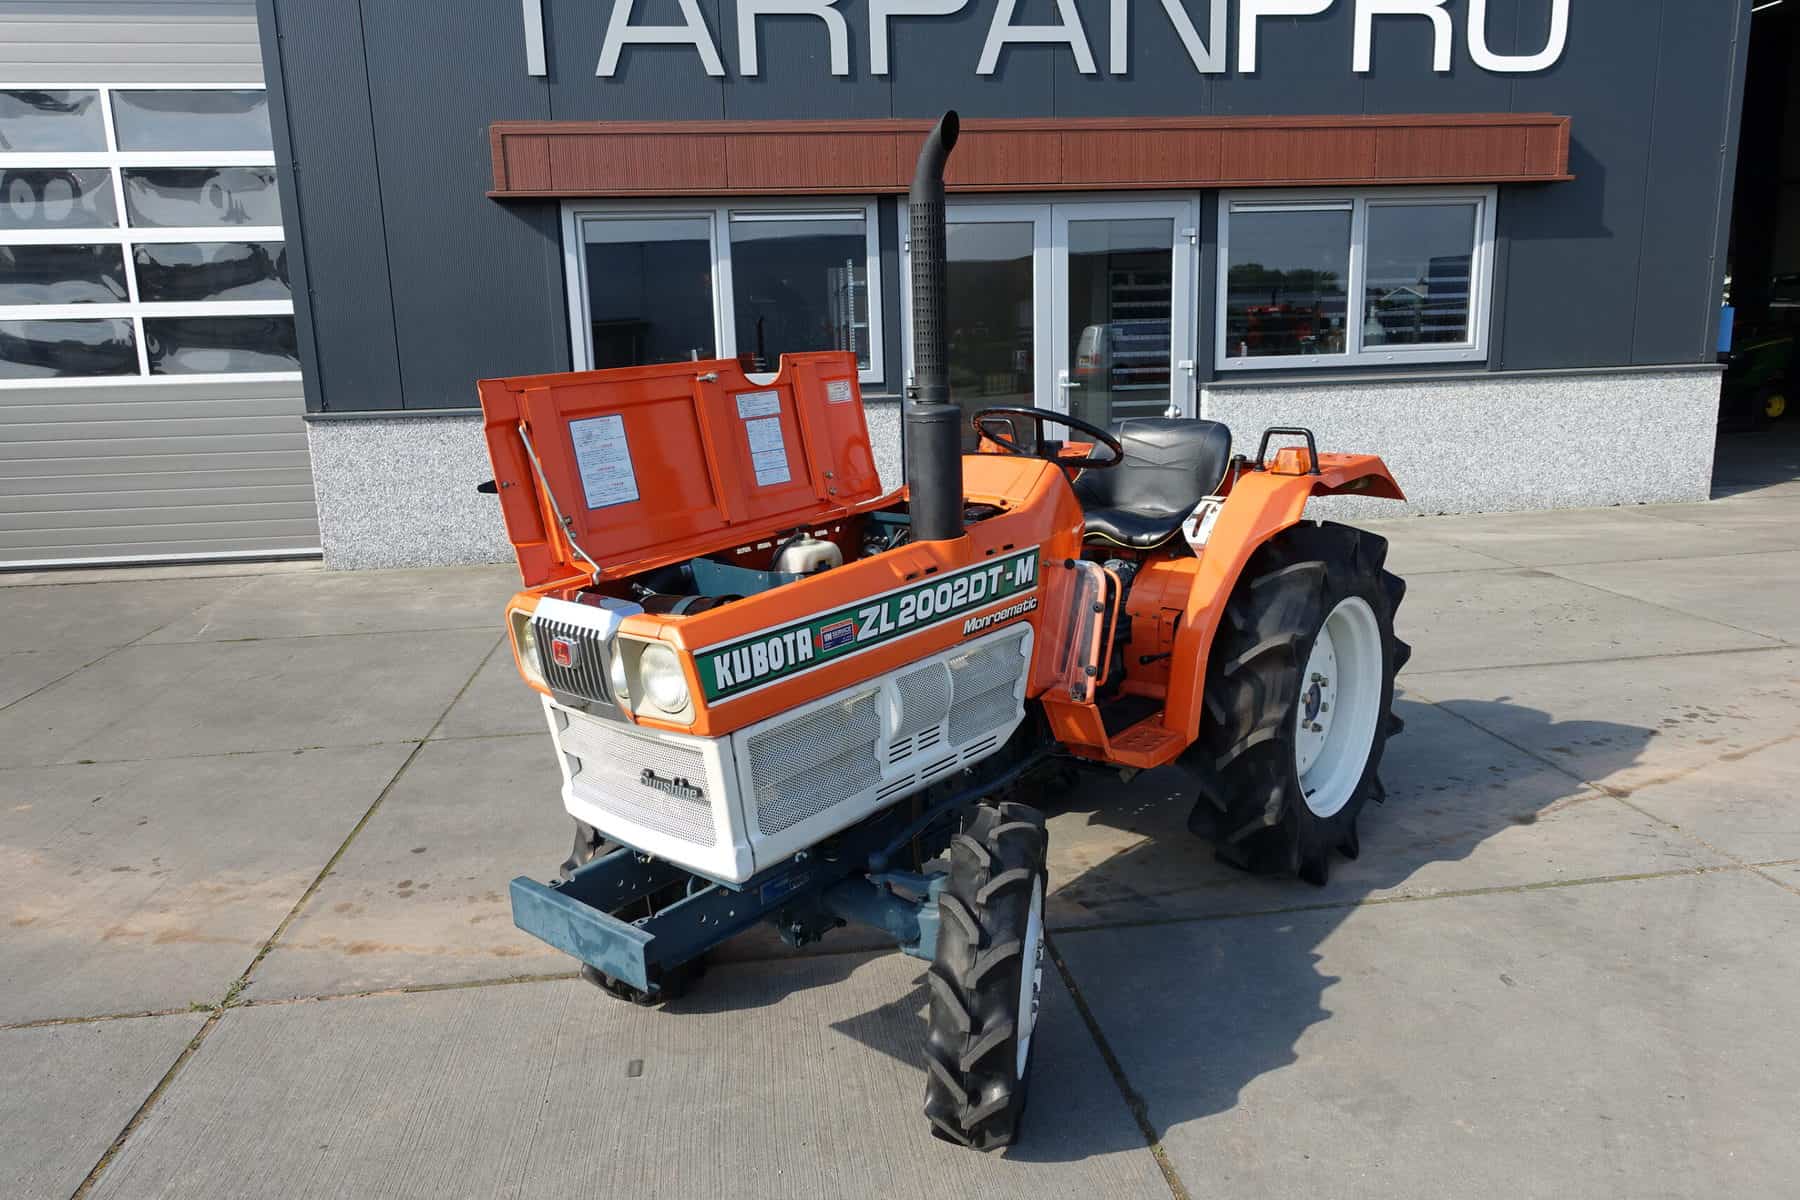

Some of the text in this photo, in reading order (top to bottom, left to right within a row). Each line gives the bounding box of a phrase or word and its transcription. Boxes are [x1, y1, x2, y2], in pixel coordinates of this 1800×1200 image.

[713, 555, 1036, 690] KUBOTA ZL2002DT-M
[640, 767, 703, 801] Sunshine
